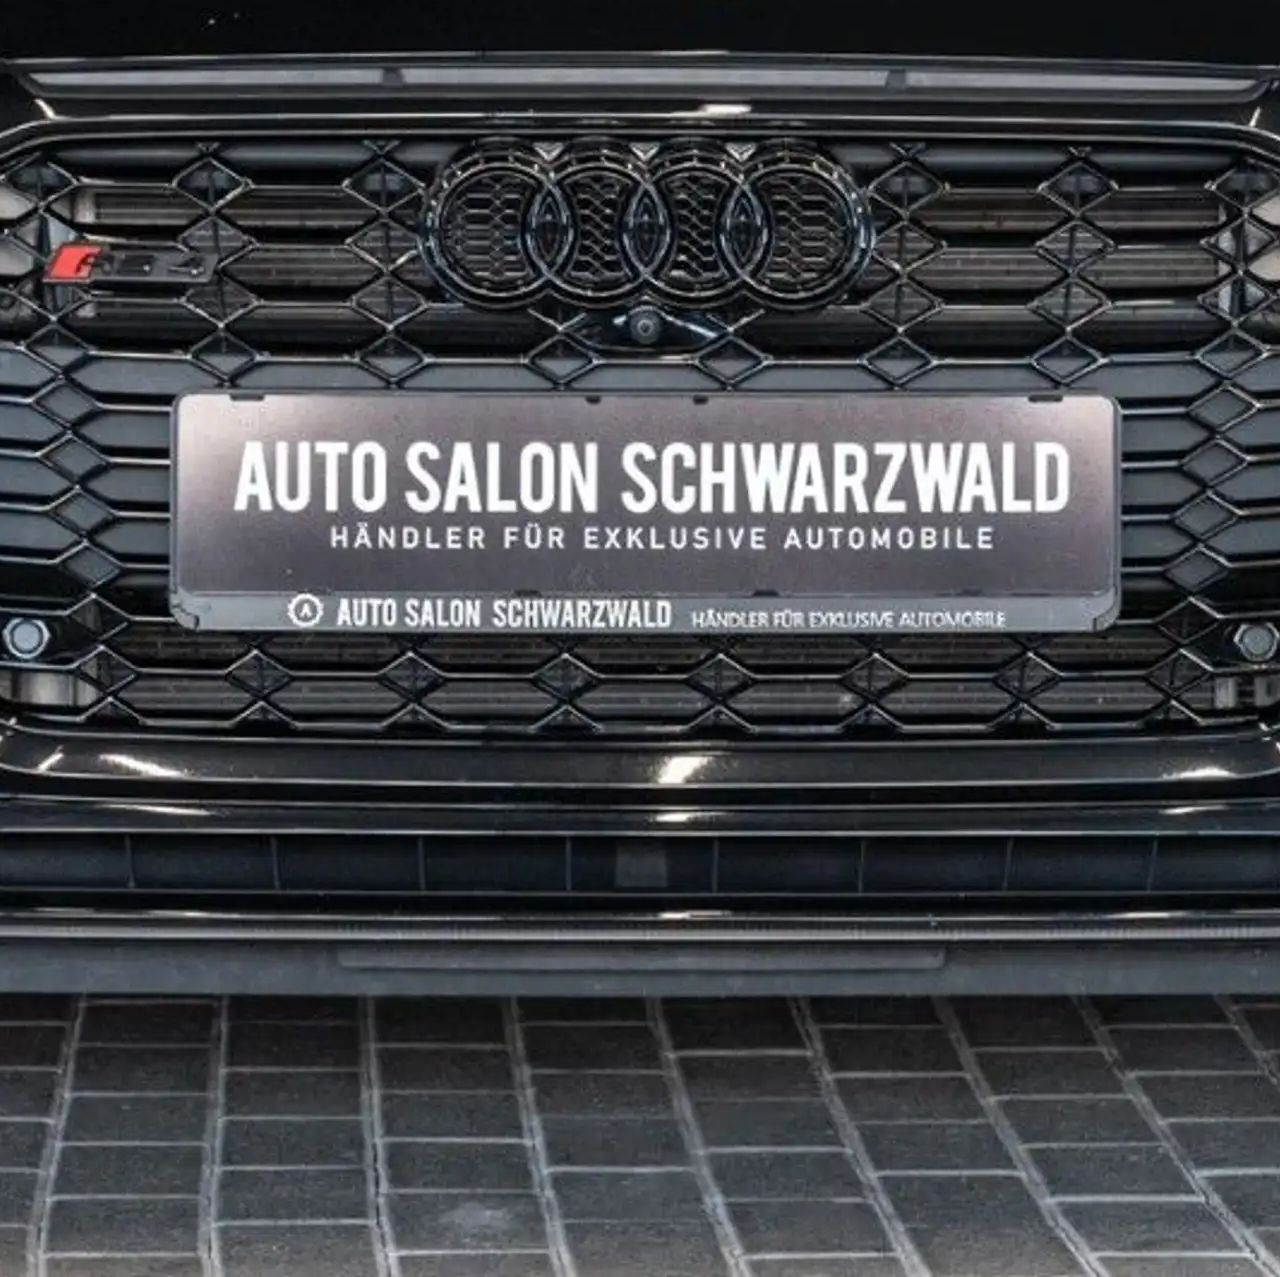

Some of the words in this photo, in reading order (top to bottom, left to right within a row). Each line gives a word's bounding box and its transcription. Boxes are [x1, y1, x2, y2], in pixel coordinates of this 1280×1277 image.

[233, 440, 388, 513] AUTO
[405, 440, 598, 513] SALON
[620, 440, 1071, 514] SCHWARZWALD
[330, 522, 486, 550] HÄNDLER
[504, 522, 565, 550] FÜR
[583, 526, 767, 551] EXKLUSIVE
[783, 526, 995, 551] AUTOMOBILE
[336, 598, 396, 627] AUTO
[404, 598, 481, 628] SALON
[492, 599, 672, 629] SCHWARZWALD
[691, 608, 769, 629] HÄNDLER
[773, 608, 805, 629] FÜR
[809, 610, 894, 629] EXKLUSIVE
[898, 610, 1007, 629] AUTOMOBILE
